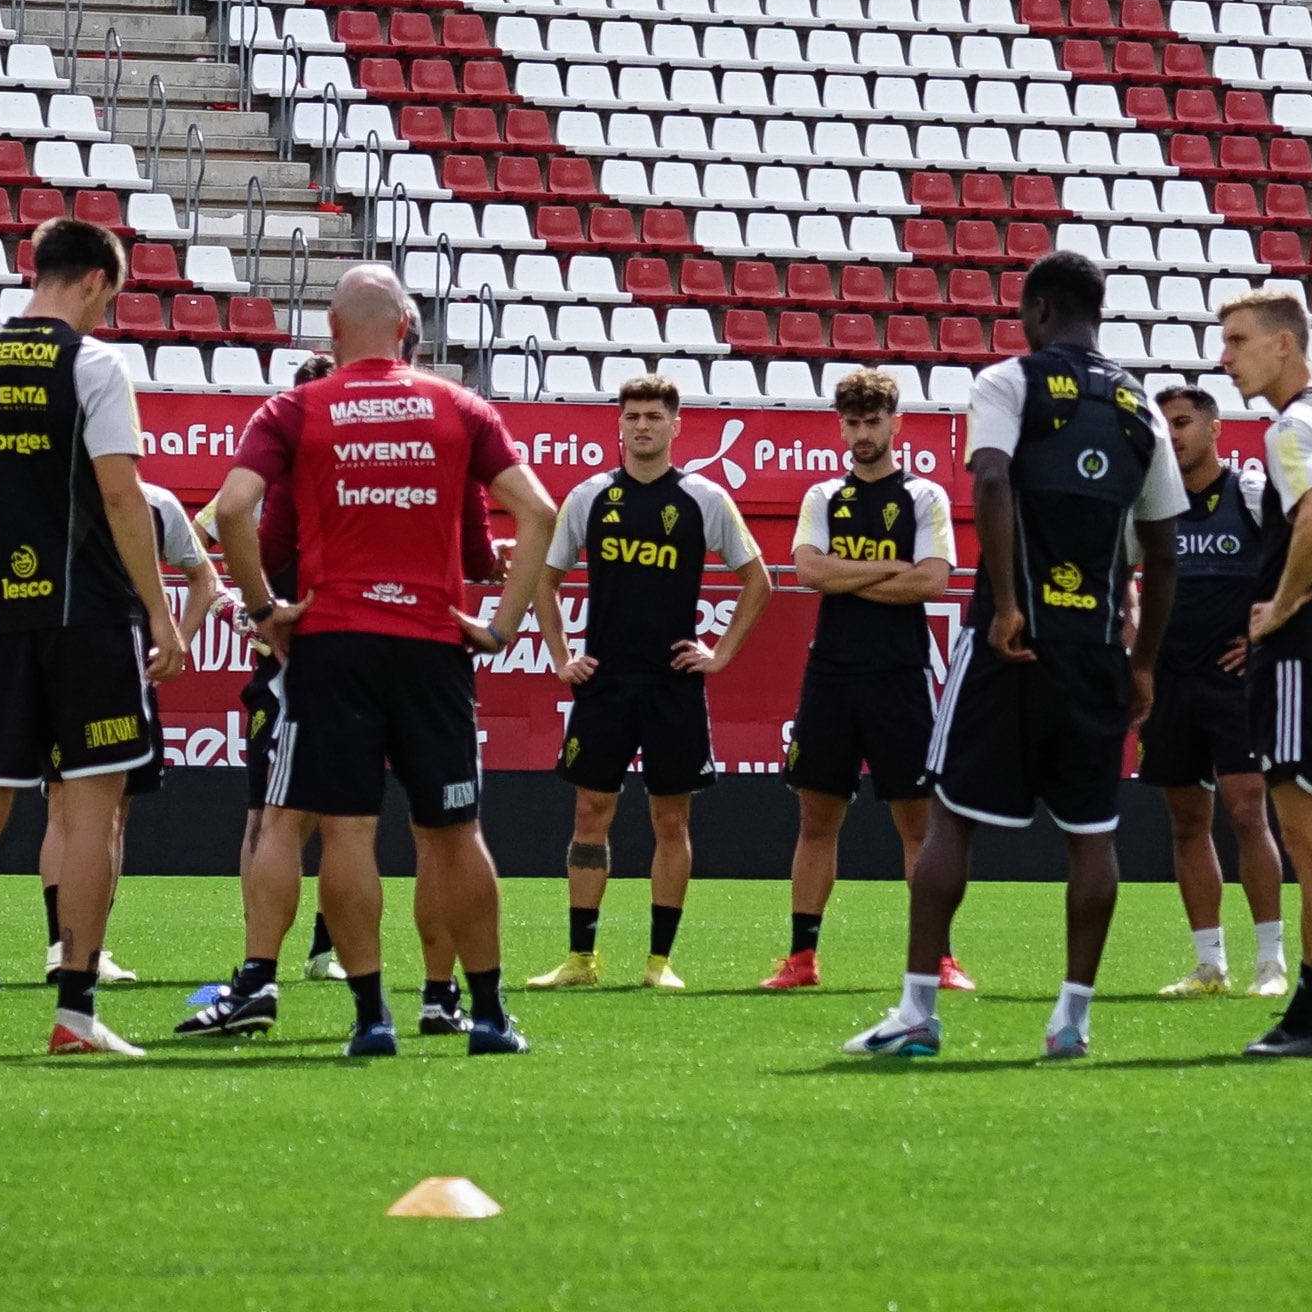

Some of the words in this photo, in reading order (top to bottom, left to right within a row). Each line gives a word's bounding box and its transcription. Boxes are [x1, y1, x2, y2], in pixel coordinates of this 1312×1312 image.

[329, 396, 434, 421] MASERCON
[333, 441, 436, 462] VIVENTA
[336, 479, 438, 510] inforges
[601, 537, 678, 570] svan
[831, 536, 896, 561] svan
[1175, 534, 1241, 555] BIKO
[2, 579, 53, 599] lesco
[1042, 584, 1098, 610] lesco
